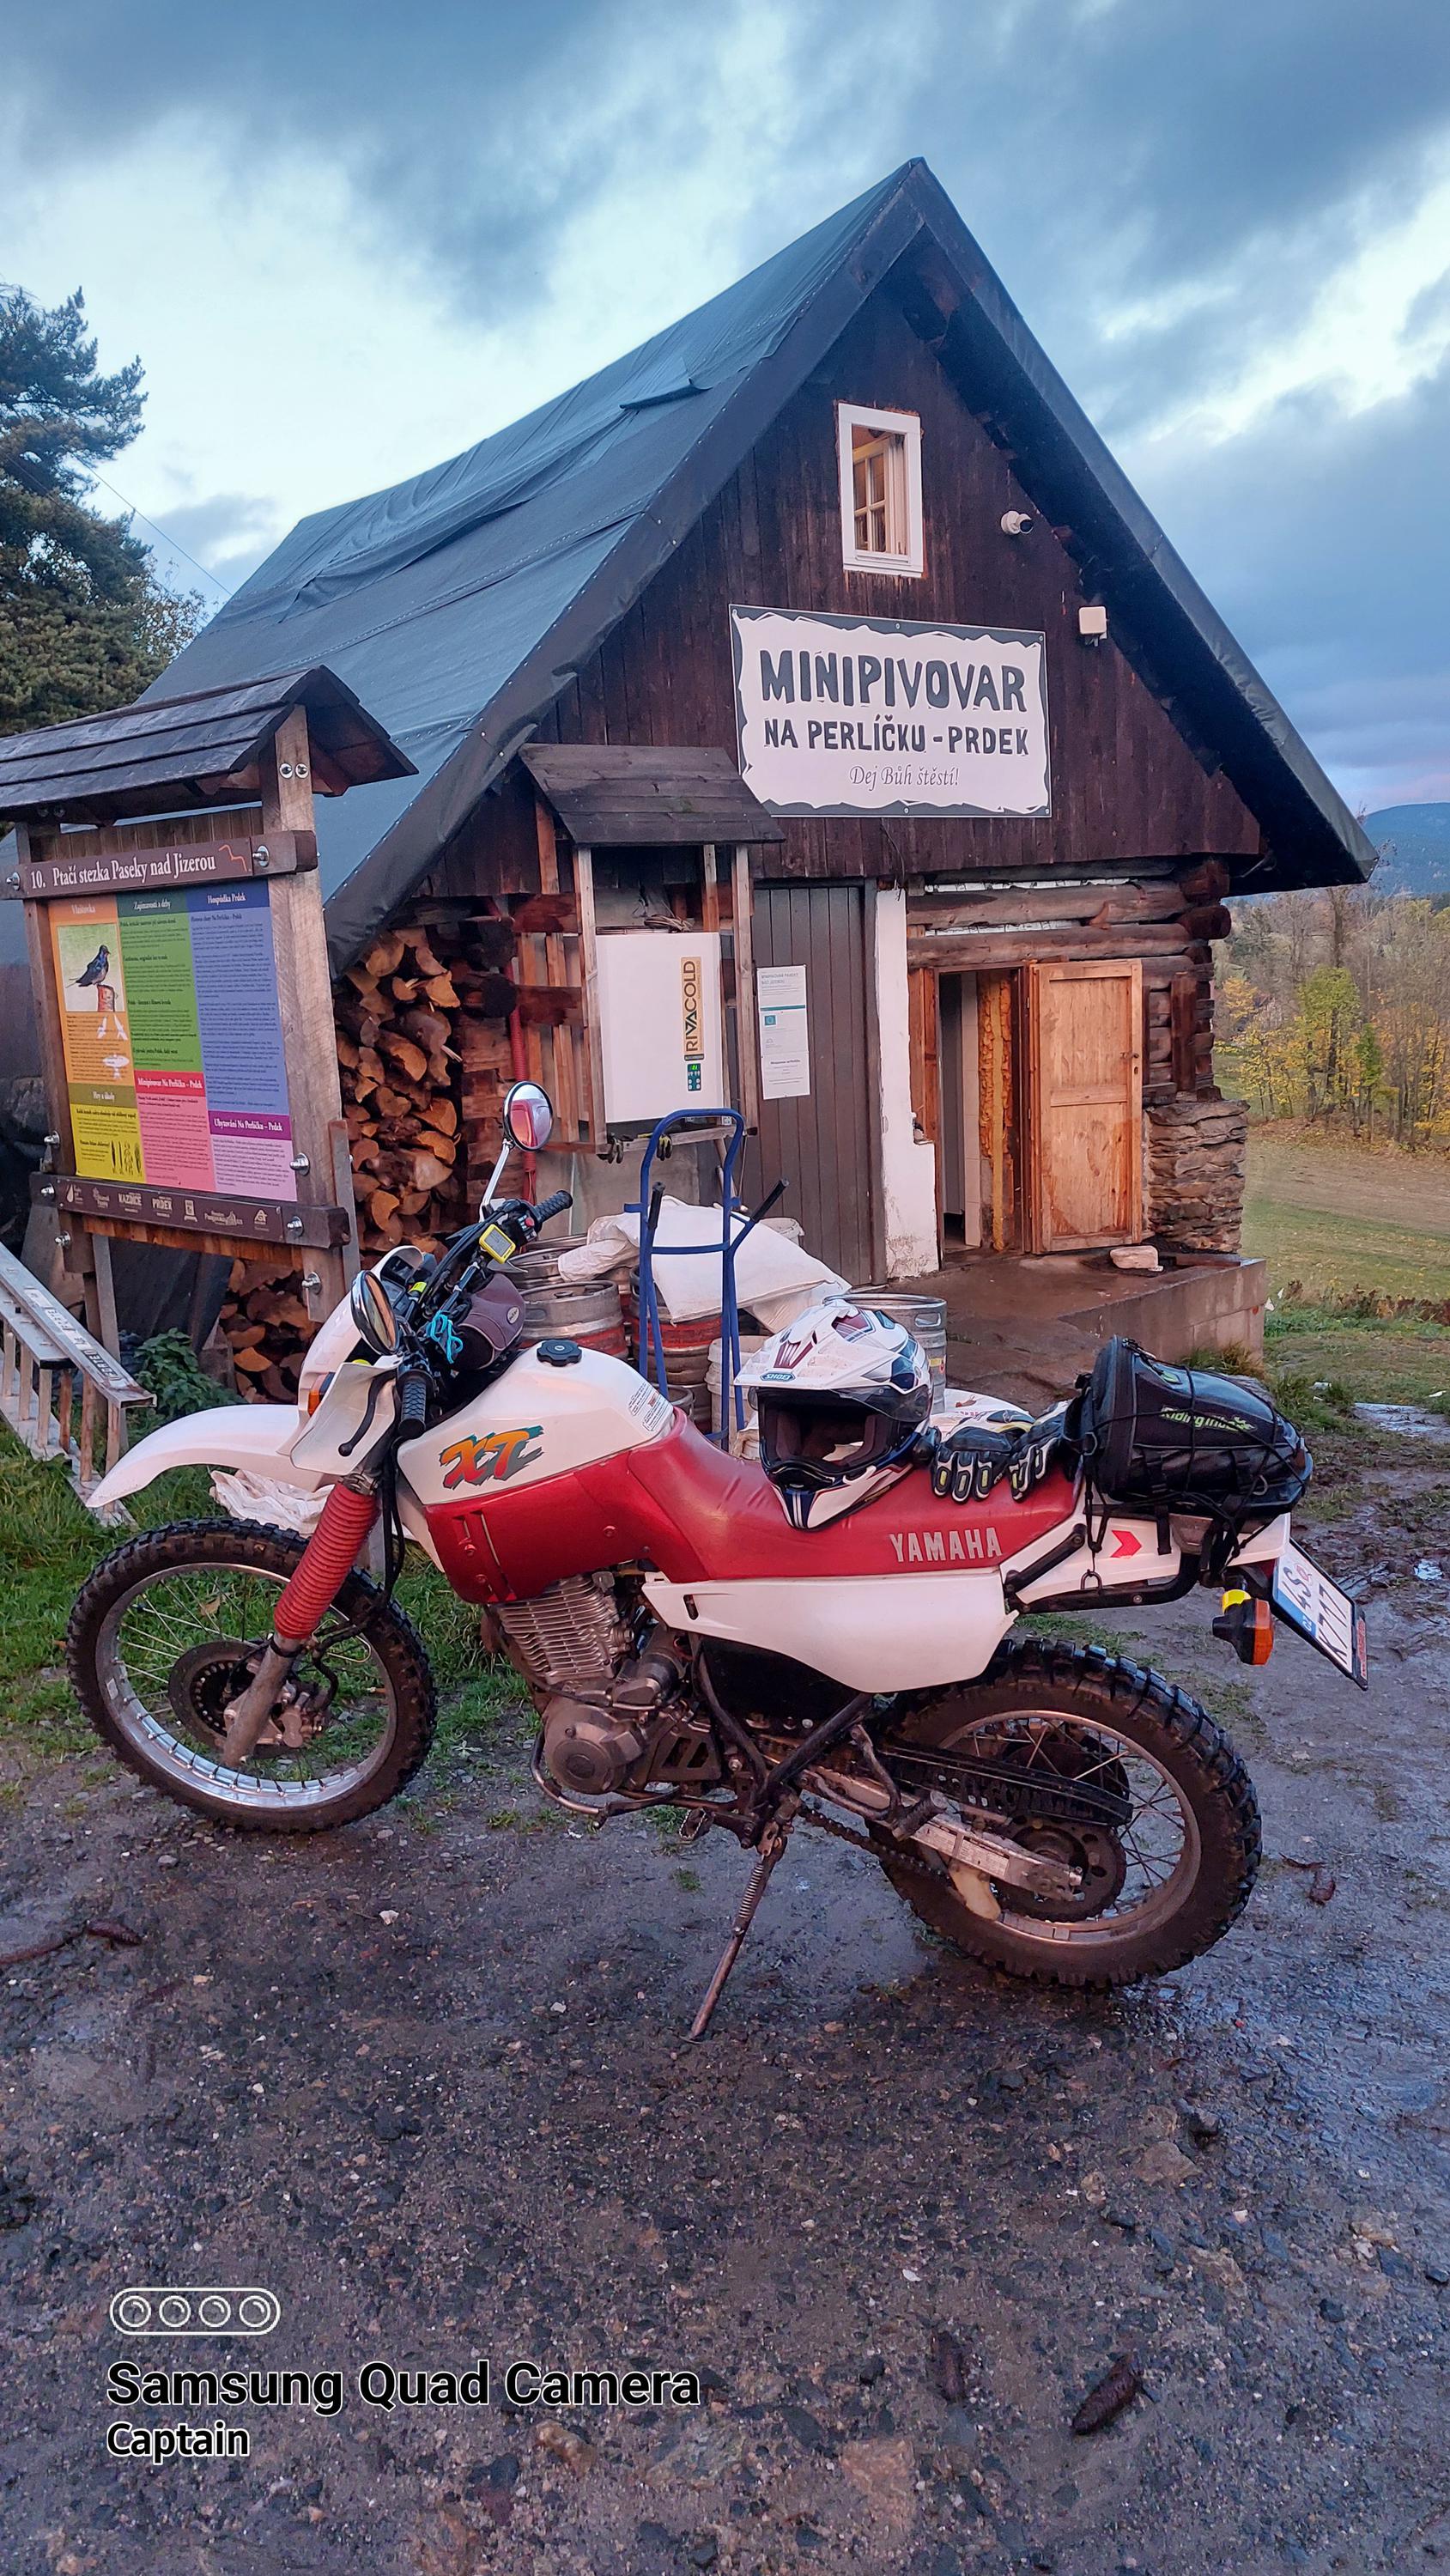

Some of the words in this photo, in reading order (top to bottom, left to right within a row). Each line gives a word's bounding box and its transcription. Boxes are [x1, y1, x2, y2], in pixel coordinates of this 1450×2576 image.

[760, 649, 1028, 713] MINIPIVOVAR
[763, 717, 798, 750] NA
[807, 714, 927, 752] PERLÍČKU
[948, 726, 1029, 756] PRDEK
[849, 764, 877, 791] Dej
[880, 765, 913, 785] Bůh
[917, 767, 959, 787] štěstí!
[30, 870, 46, 890] 10.
[52, 864, 79, 887] Ptačí
[78, 865, 110, 884] stezka
[112, 858, 148, 884] Paseky
[150, 859, 172, 876] nad
[173, 853, 216, 878] Jizerou
[683, 960, 698, 1052] RIVACOLD
[440, 1425, 544, 1490] XT
[889, 1527, 1003, 1563] YAMAHA
[1319, 1583, 1348, 1665] K717
